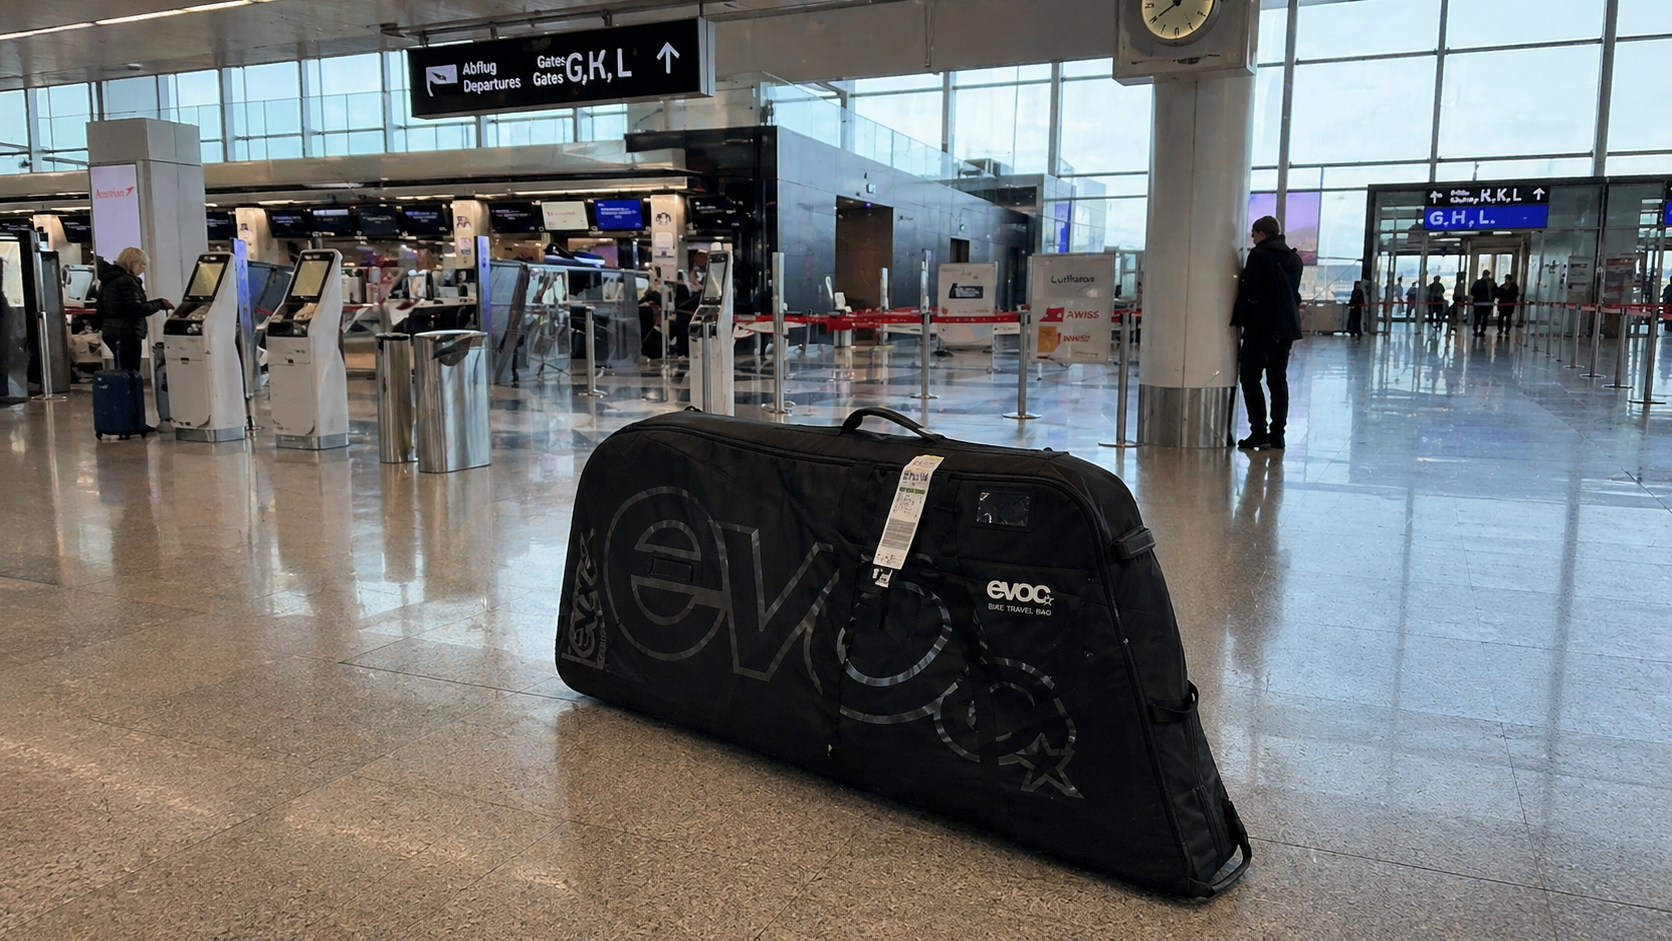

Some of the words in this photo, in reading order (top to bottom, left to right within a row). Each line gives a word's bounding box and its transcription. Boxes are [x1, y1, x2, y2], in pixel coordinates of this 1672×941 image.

[462, 60, 497, 76] Abflug
[537, 55, 565, 69] Gates
[463, 77, 522, 95] Departures
[533, 71, 563, 86] Gates
[986, 580, 1051, 604] evoc
[1006, 605, 1034, 615] TRAVEL
